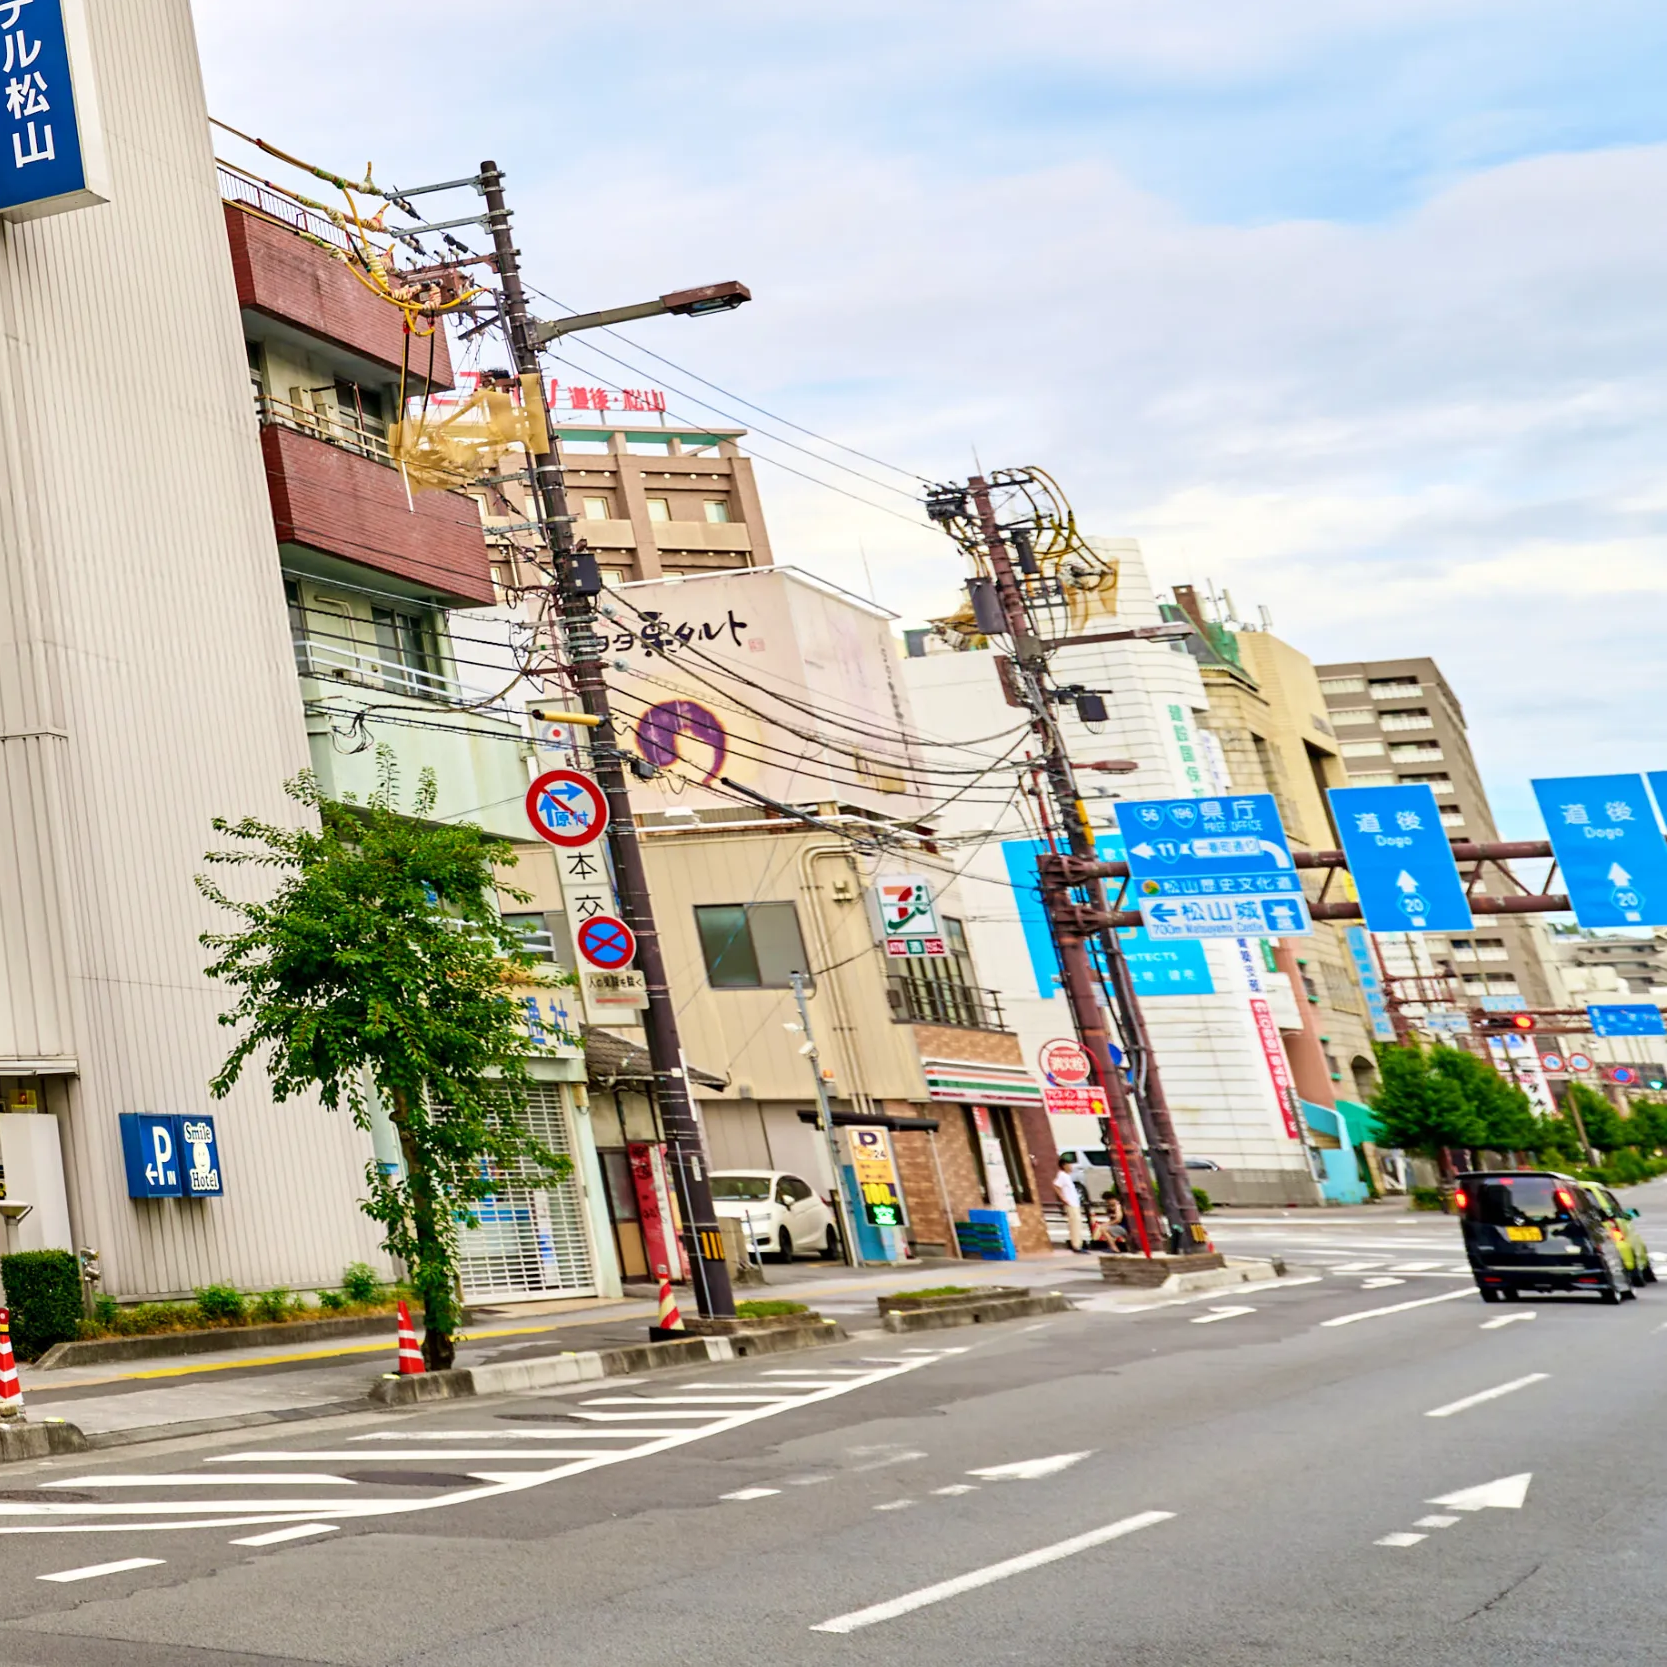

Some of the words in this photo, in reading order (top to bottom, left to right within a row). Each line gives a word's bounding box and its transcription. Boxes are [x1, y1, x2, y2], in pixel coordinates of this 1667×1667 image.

[1140, 808, 1160, 823] 56
[1172, 807, 1194, 820] 196
[1199, 800, 1257, 821] 県庁
[1558, 800, 1637, 824] 道後
[553, 810, 589, 828] 原付
[1352, 810, 1425, 833] 道後
[1374, 834, 1413, 848] Dogo
[1583, 826, 1625, 840] Dogo
[1158, 843, 1175, 857] 11
[1403, 898, 1424, 913] 20
[1616, 892, 1638, 907] 20
[1181, 901, 1262, 922] 松山城
[183, 1122, 213, 1144] Smile
[152, 1126, 172, 1185] P
[167, 1170, 177, 1185] IN
[190, 1169, 220, 1191] Hotel
